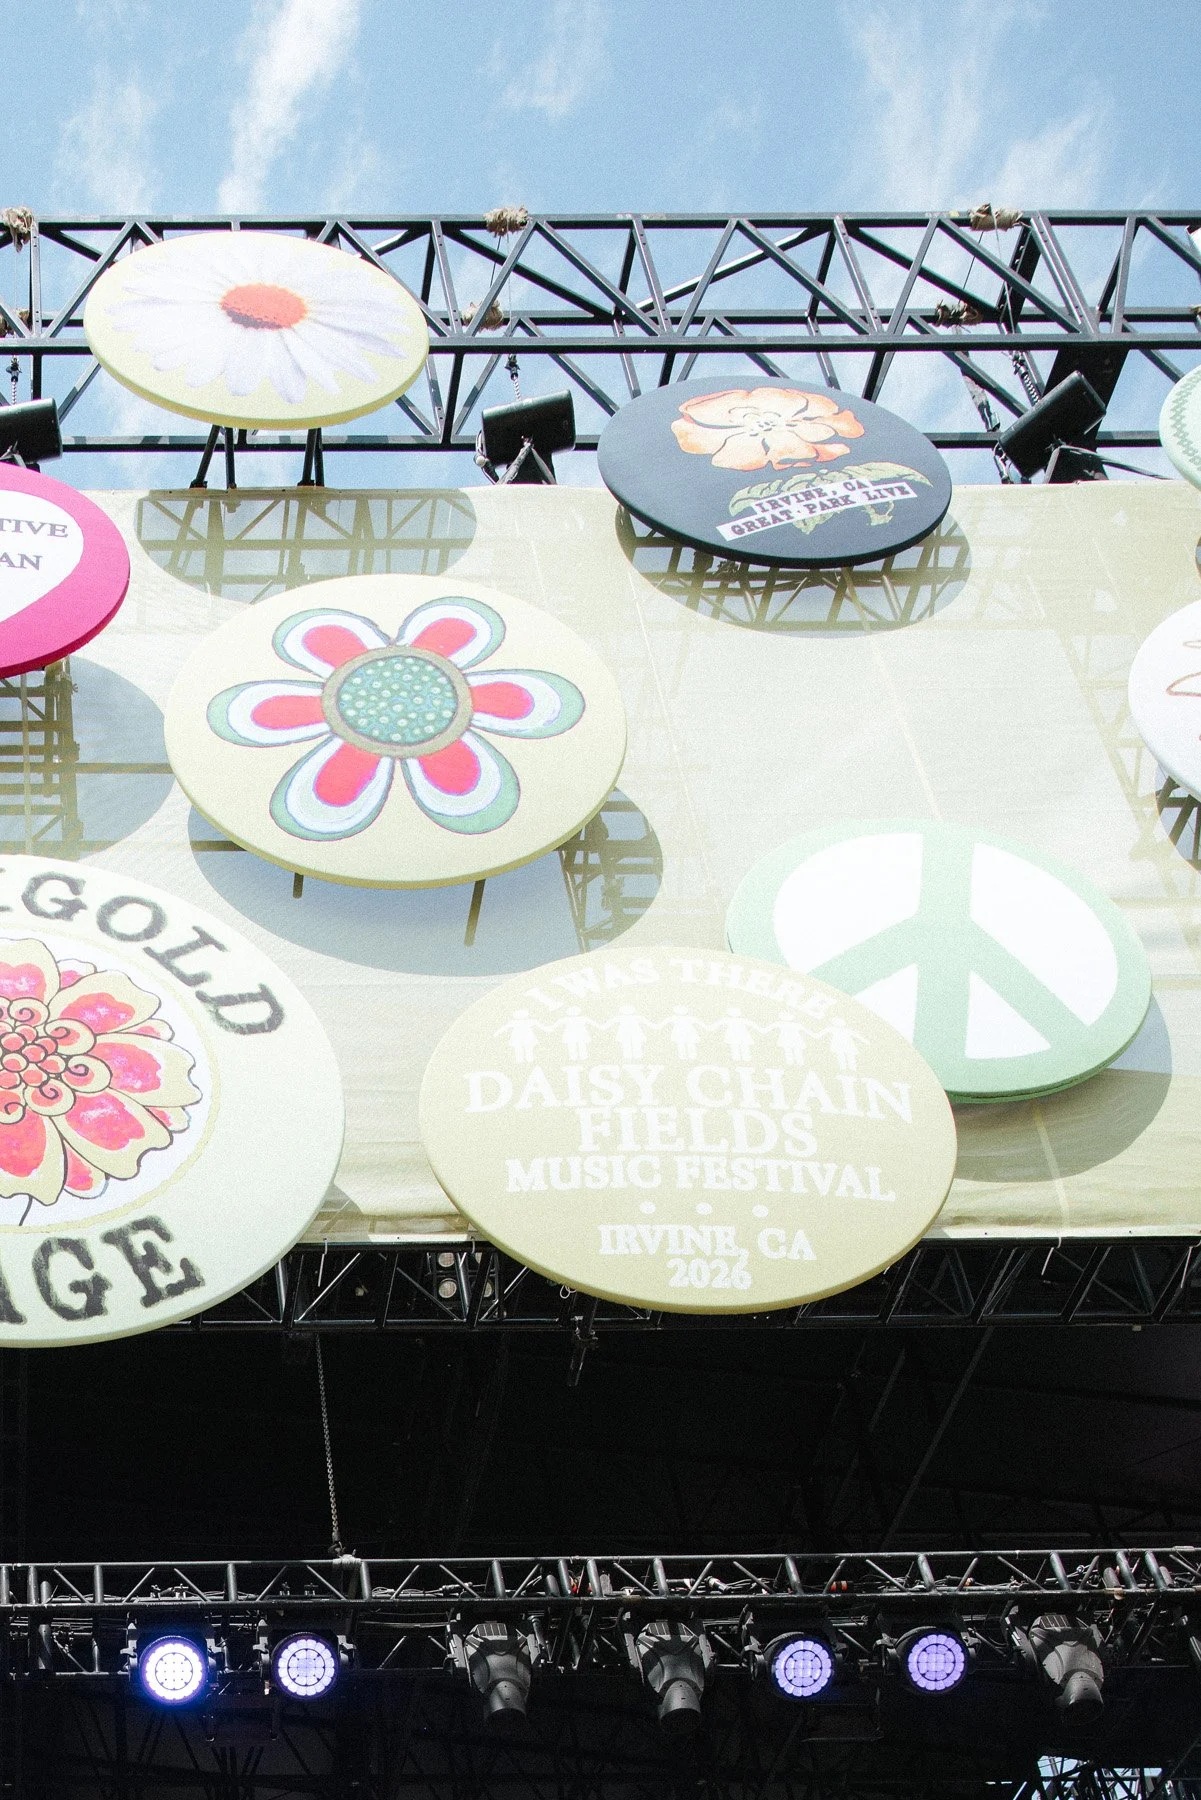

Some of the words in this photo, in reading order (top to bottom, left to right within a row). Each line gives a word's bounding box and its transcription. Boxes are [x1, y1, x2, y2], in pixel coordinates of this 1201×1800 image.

[803, 494, 856, 514] PARK
[863, 485, 911, 501] LIVE
[843, 480, 869, 492] CA
[524, 987, 563, 1011] I
[551, 958, 660, 998] WAS
[669, 958, 838, 1020] THERE
[462, 1064, 664, 1114] DAISY
[685, 1066, 916, 1124] CHAIN
[578, 1106, 818, 1158] FIELDS
[503, 1155, 662, 1194] MUSIC
[675, 1155, 896, 1202] FESTIVAL
[598, 1224, 749, 1264] IRVINE,
[757, 1227, 817, 1260] CA
[666, 1257, 752, 1290] 2026
